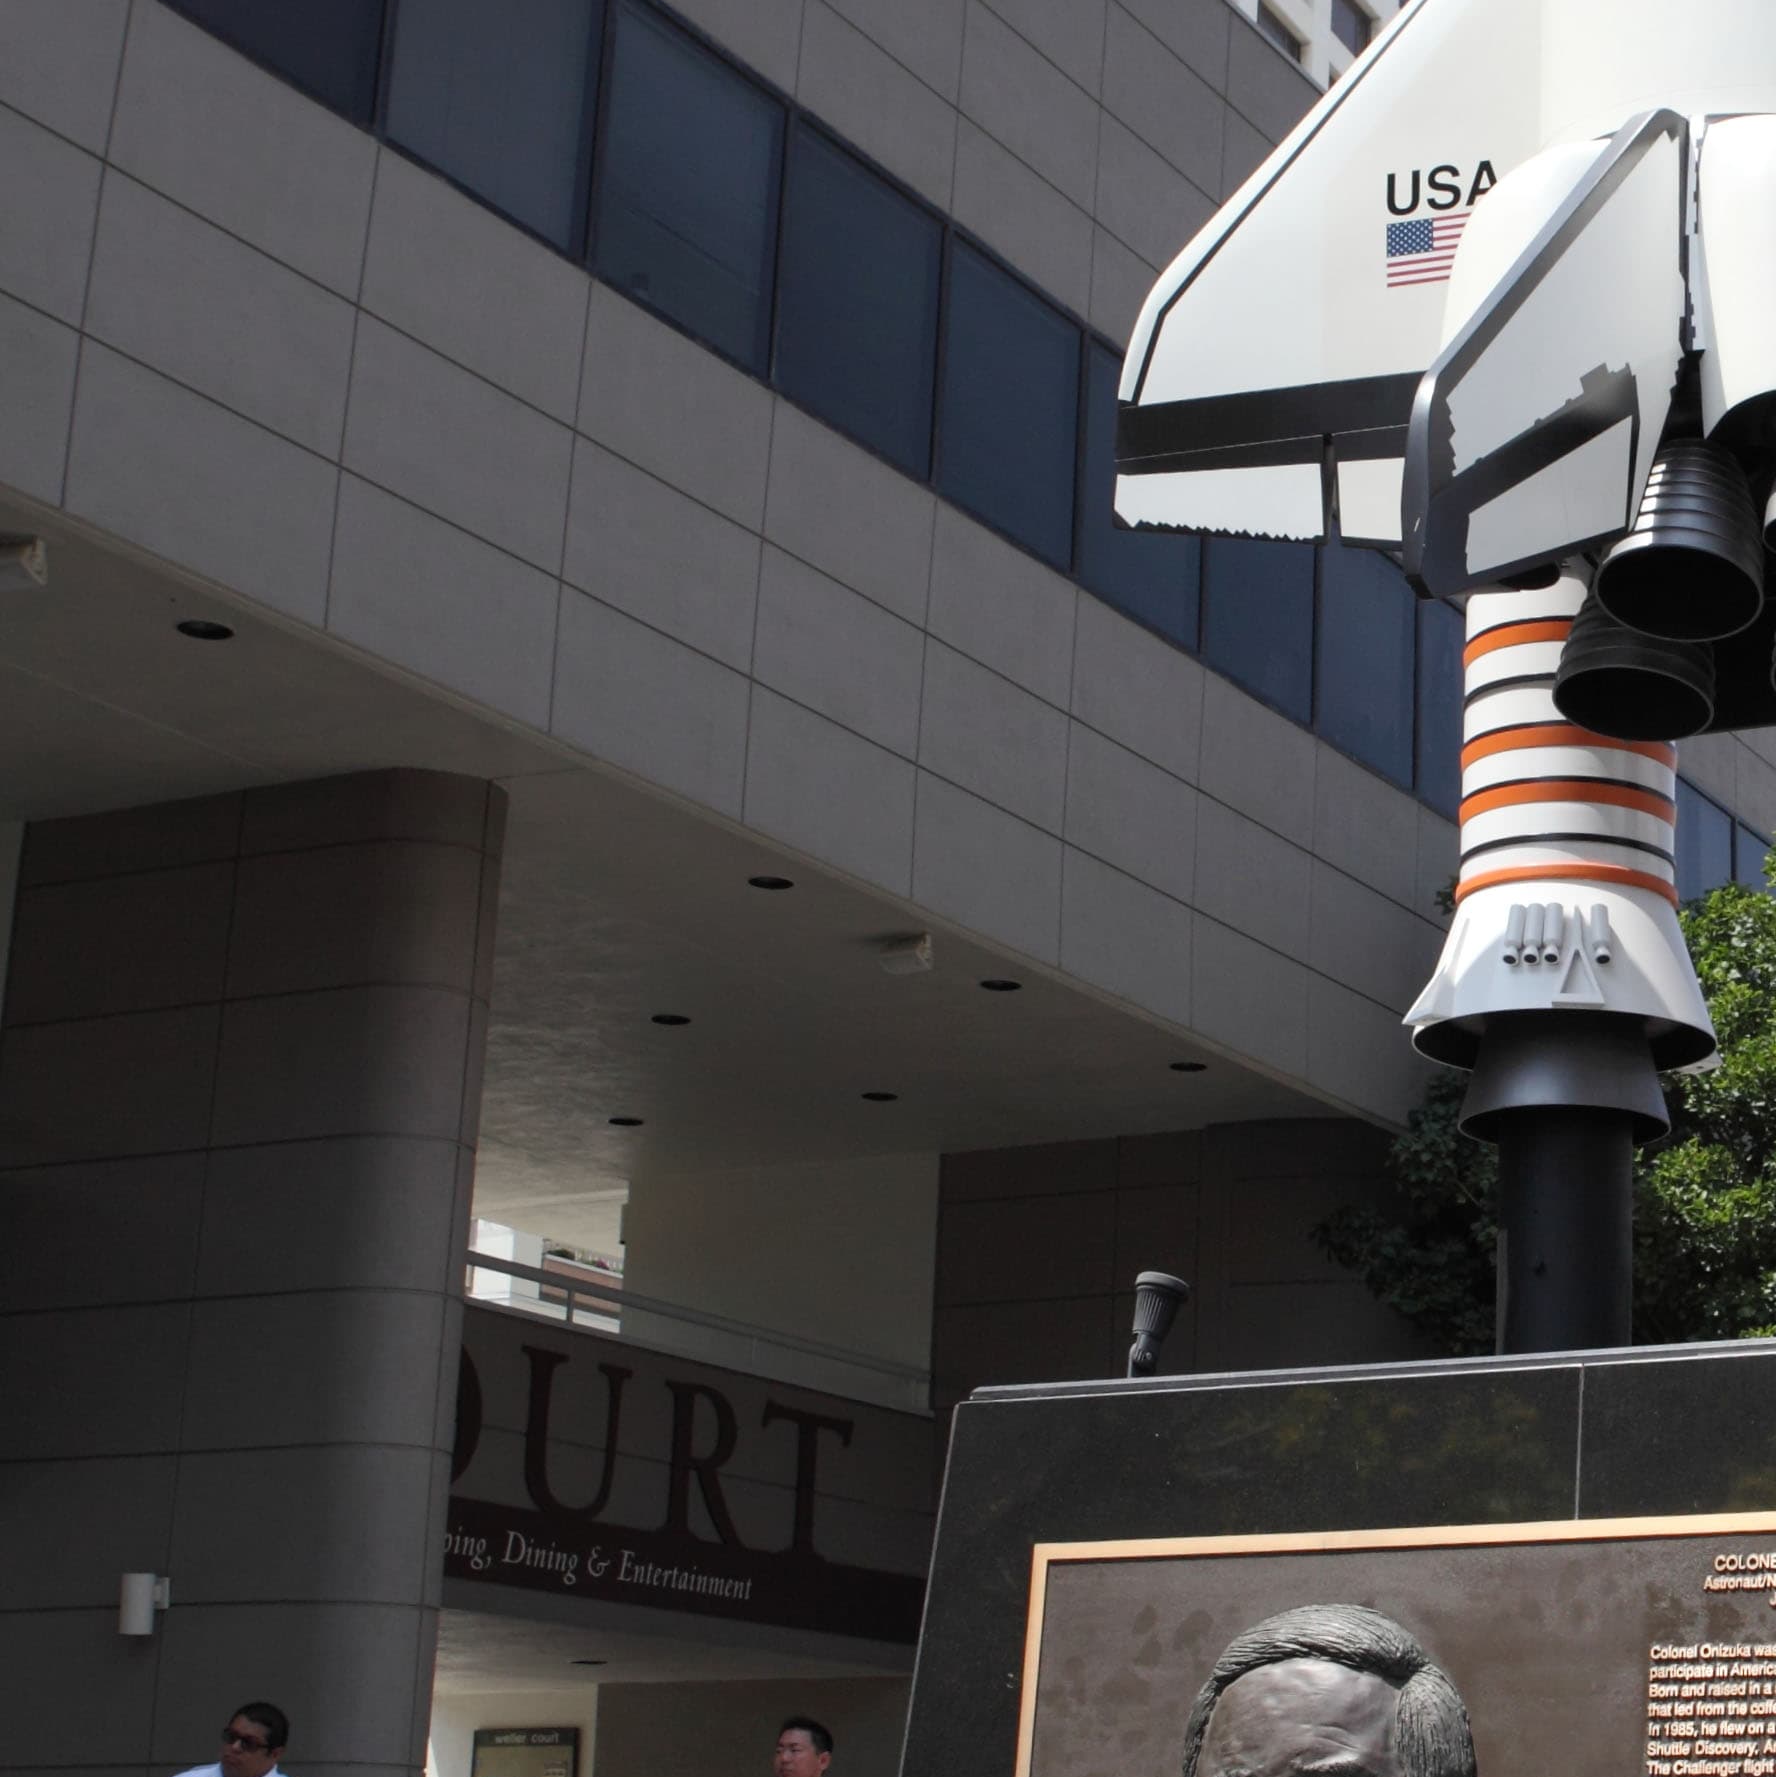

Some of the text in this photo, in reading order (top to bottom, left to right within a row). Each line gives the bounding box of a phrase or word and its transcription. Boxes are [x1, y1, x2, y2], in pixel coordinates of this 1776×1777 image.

[1386, 160, 1498, 216] USA
[503, 1530, 579, 1586] Dining
[587, 1545, 611, 1578] &
[616, 1549, 754, 1601] Entertainment
[1650, 1644, 1698, 1660] Colonel
[1700, 1643, 1751, 1659] Onizuka
[1650, 1663, 1714, 1681] participate
[1648, 1683, 1678, 1698] Born
[1681, 1682, 1705, 1696] and
[1708, 1681, 1746, 1696] raised
[1648, 1702, 1672, 1717] that
[1674, 1702, 1693, 1716] led
[1696, 1701, 1725, 1716] from
[1727, 1700, 1748, 1715] the
[531, 1731, 560, 1743] court
[1664, 1721, 1698, 1738] 1985,
[1720, 1720, 1745, 1735] flew
[1647, 1741, 1690, 1756] Shuttle
[1694, 1739, 1759, 1757] Discovery,
[1646, 1761, 1671, 1775] The
[1673, 1759, 1743, 1777] Challenger
[1743, 1759, 1774, 1777] flight
